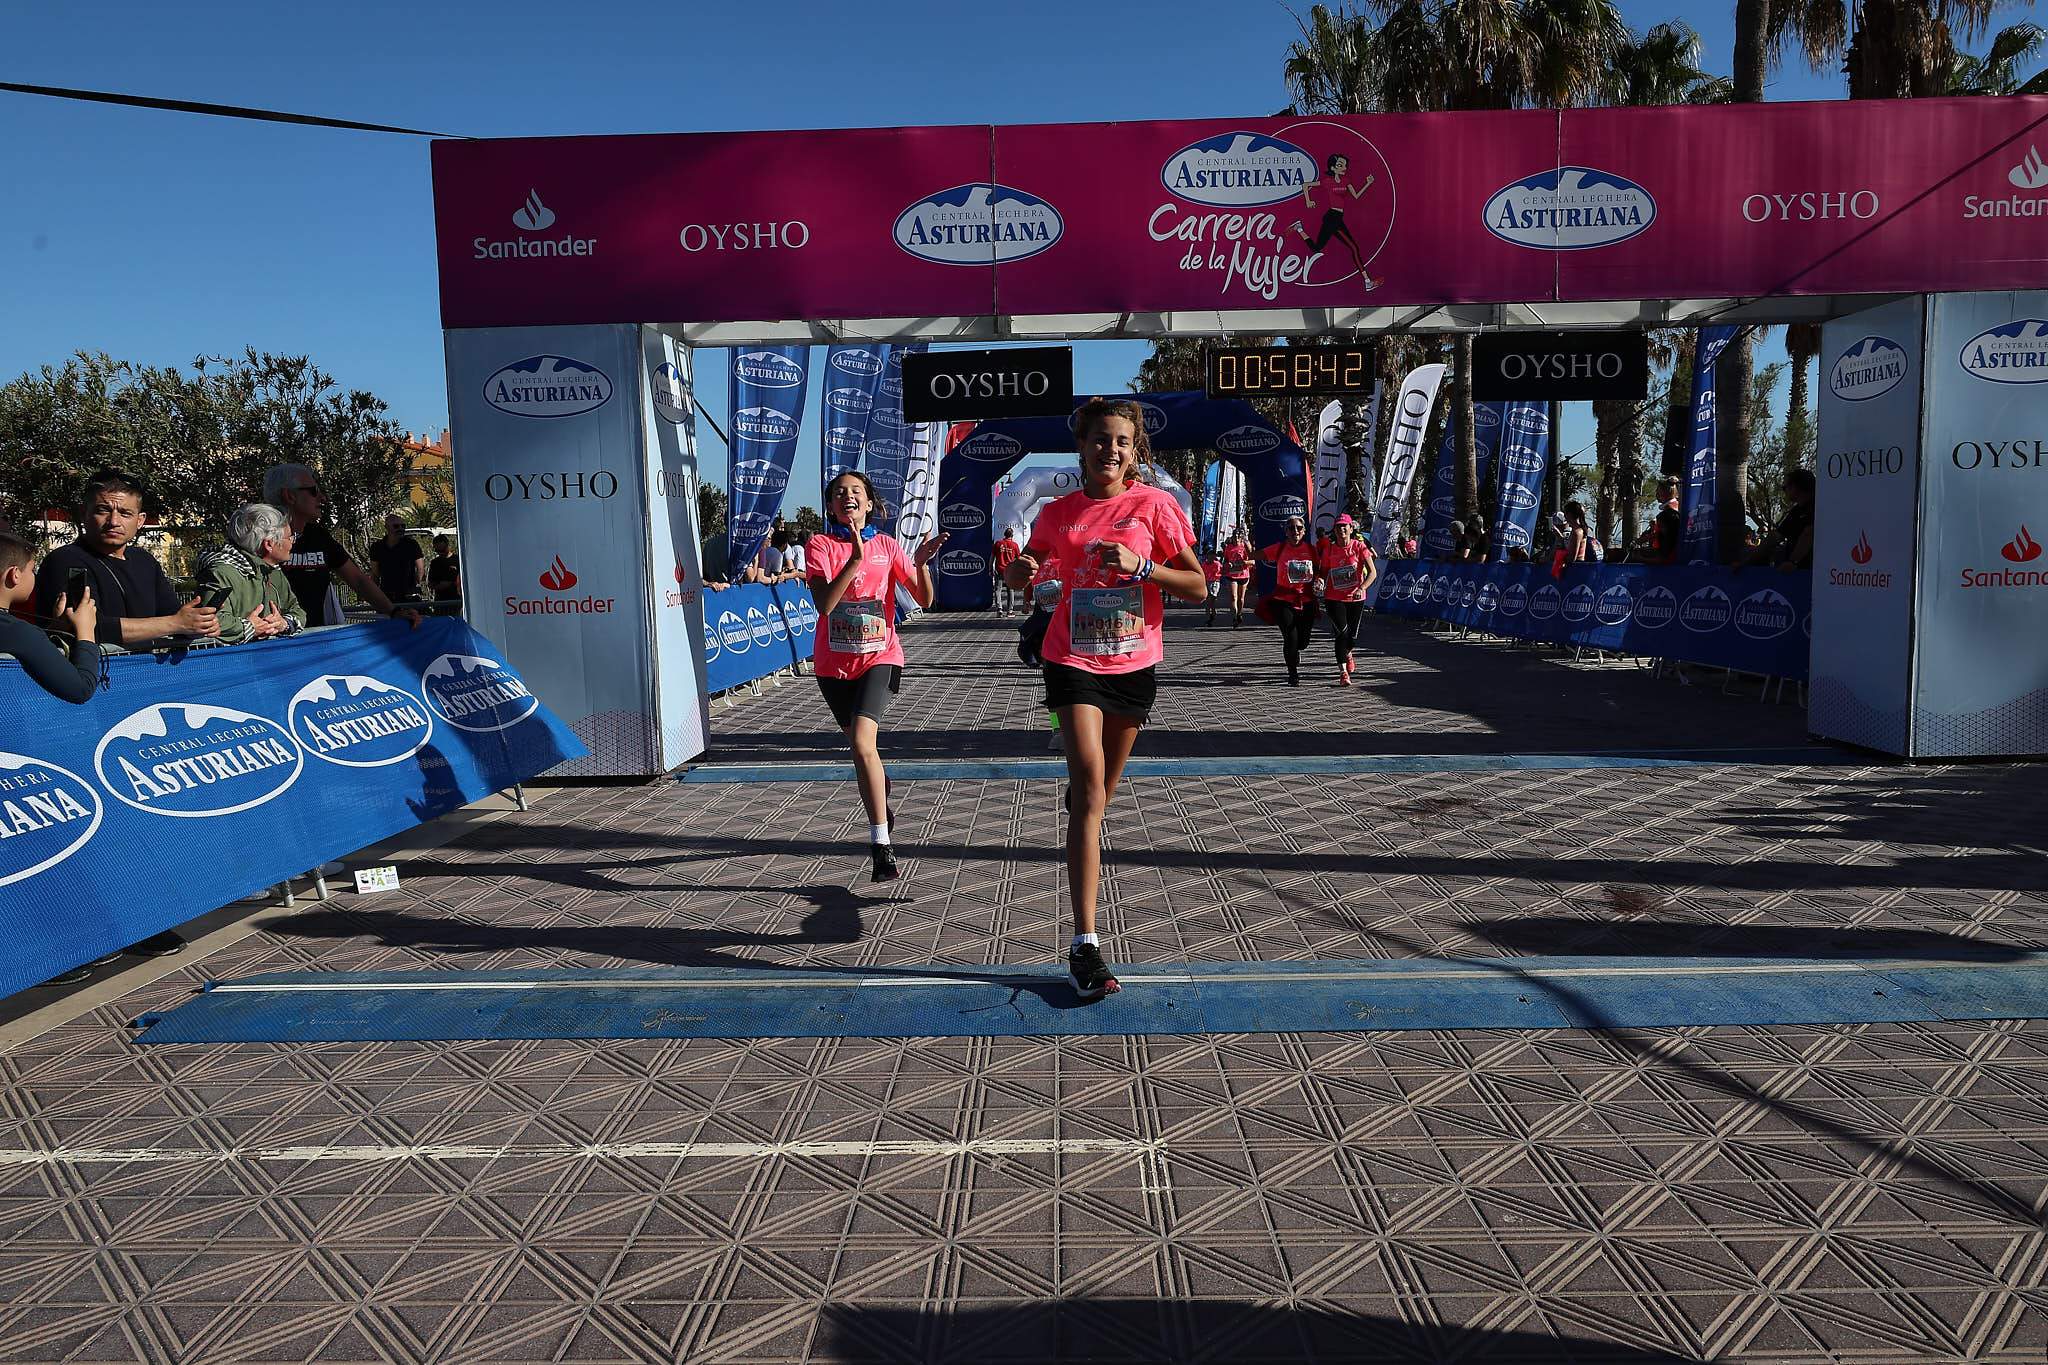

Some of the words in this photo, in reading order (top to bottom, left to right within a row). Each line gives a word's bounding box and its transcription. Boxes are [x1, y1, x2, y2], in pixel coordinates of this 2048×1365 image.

[1197, 156, 1247, 166] CENTRAL
[1251, 154, 1302, 165] LECHERA
[1173, 160, 1306, 189] ASTURIANA
[1522, 195, 1577, 205] CENTRAL
[1581, 193, 1638, 203] LECHERA
[1742, 189, 1880, 223] OYSHO
[931, 210, 985, 221] CENTRAL
[1147, 202, 1276, 243] Carrera
[1495, 197, 1643, 229] ASTURIANA
[679, 220, 810, 252] OYSHO
[905, 214, 1051, 246] ASTURIANA
[473, 233, 597, 259] Santander
[1179, 243, 1204, 270] de
[1208, 242, 1226, 270] la
[1222, 232, 1325, 300] Mujer
[1968, 343, 2048, 369] ASTURI
[1990, 341, 2032, 350] CENTRAL
[736, 360, 798, 383] ASTURIANA
[835, 357, 879, 374] ASTURIANA
[1218, 351, 1363, 389] 00:58:42
[1499, 351, 1623, 380] OYSHO
[1834, 363, 1901, 390] ASTURIANA
[493, 379, 605, 404] ASTURIANA
[512, 375, 553, 385] CENTRAL
[557, 374, 600, 384] LECHERA
[929, 370, 1050, 398] OYSHO
[735, 415, 794, 436] ASTURIANA
[963, 444, 1017, 455] ASTURIANA
[1222, 437, 1277, 449] ASTURIANA
[1378, 388, 1430, 522] OYSHO
[1827, 445, 1904, 479] OYSHO
[484, 470, 618, 501] OYSHO
[656, 468, 694, 500] OYSHO
[941, 514, 982, 524] ASTURIANA
[940, 560, 982, 570] ASTURIANA
[1829, 567, 1892, 589] Santander
[505, 595, 615, 617] Santander
[1636, 604, 1673, 618] ASTURIANA
[1682, 605, 1727, 622] ASTURIANA
[1737, 607, 1788, 629] ASTURIANA
[315, 704, 363, 721] CENTRAL
[362, 692, 405, 711] LECHERA
[303, 699, 428, 753] ASTURIANA
[137, 738, 207, 760] CENTRAL
[206, 722, 268, 748] LECHERA
[118, 737, 297, 803] ASTURIANA
